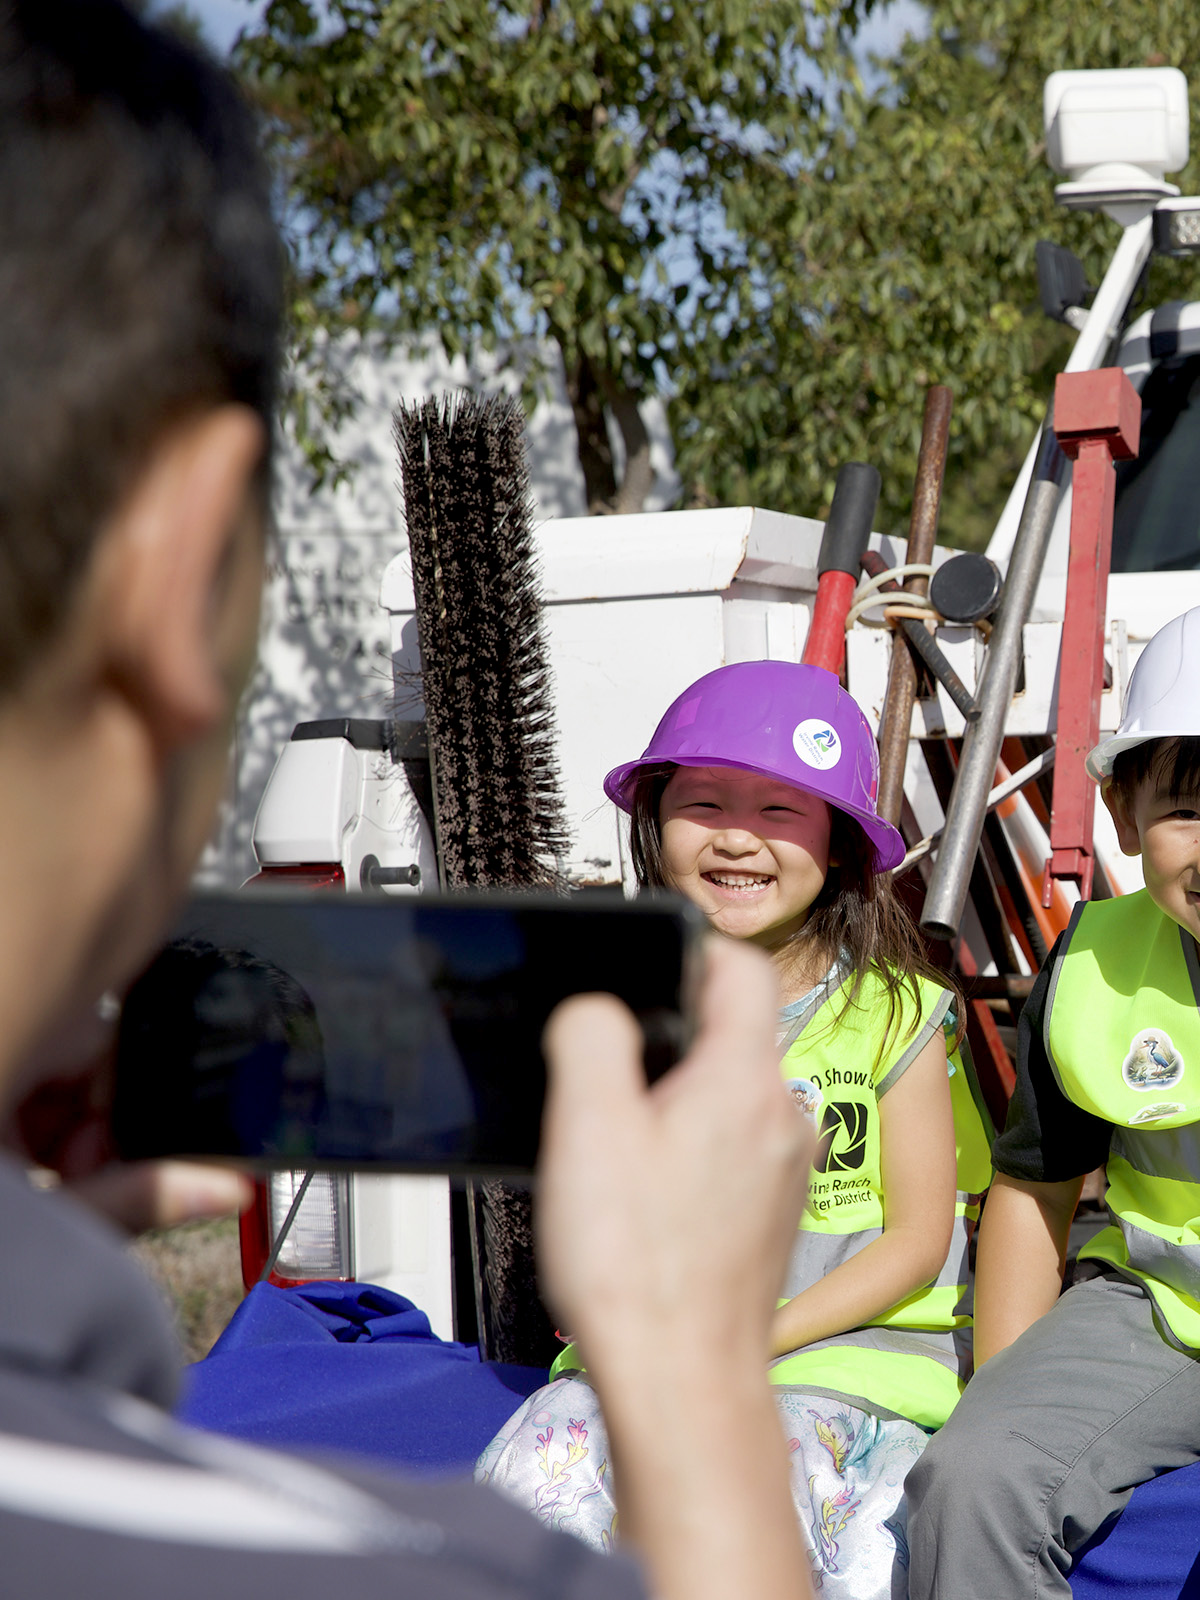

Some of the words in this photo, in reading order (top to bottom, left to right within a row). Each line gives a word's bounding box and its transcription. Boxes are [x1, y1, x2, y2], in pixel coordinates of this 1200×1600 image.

[825, 1067, 868, 1088] Show
[832, 1177, 872, 1192] Ranch
[812, 1199, 831, 1211] ter
[834, 1189, 873, 1207] District
